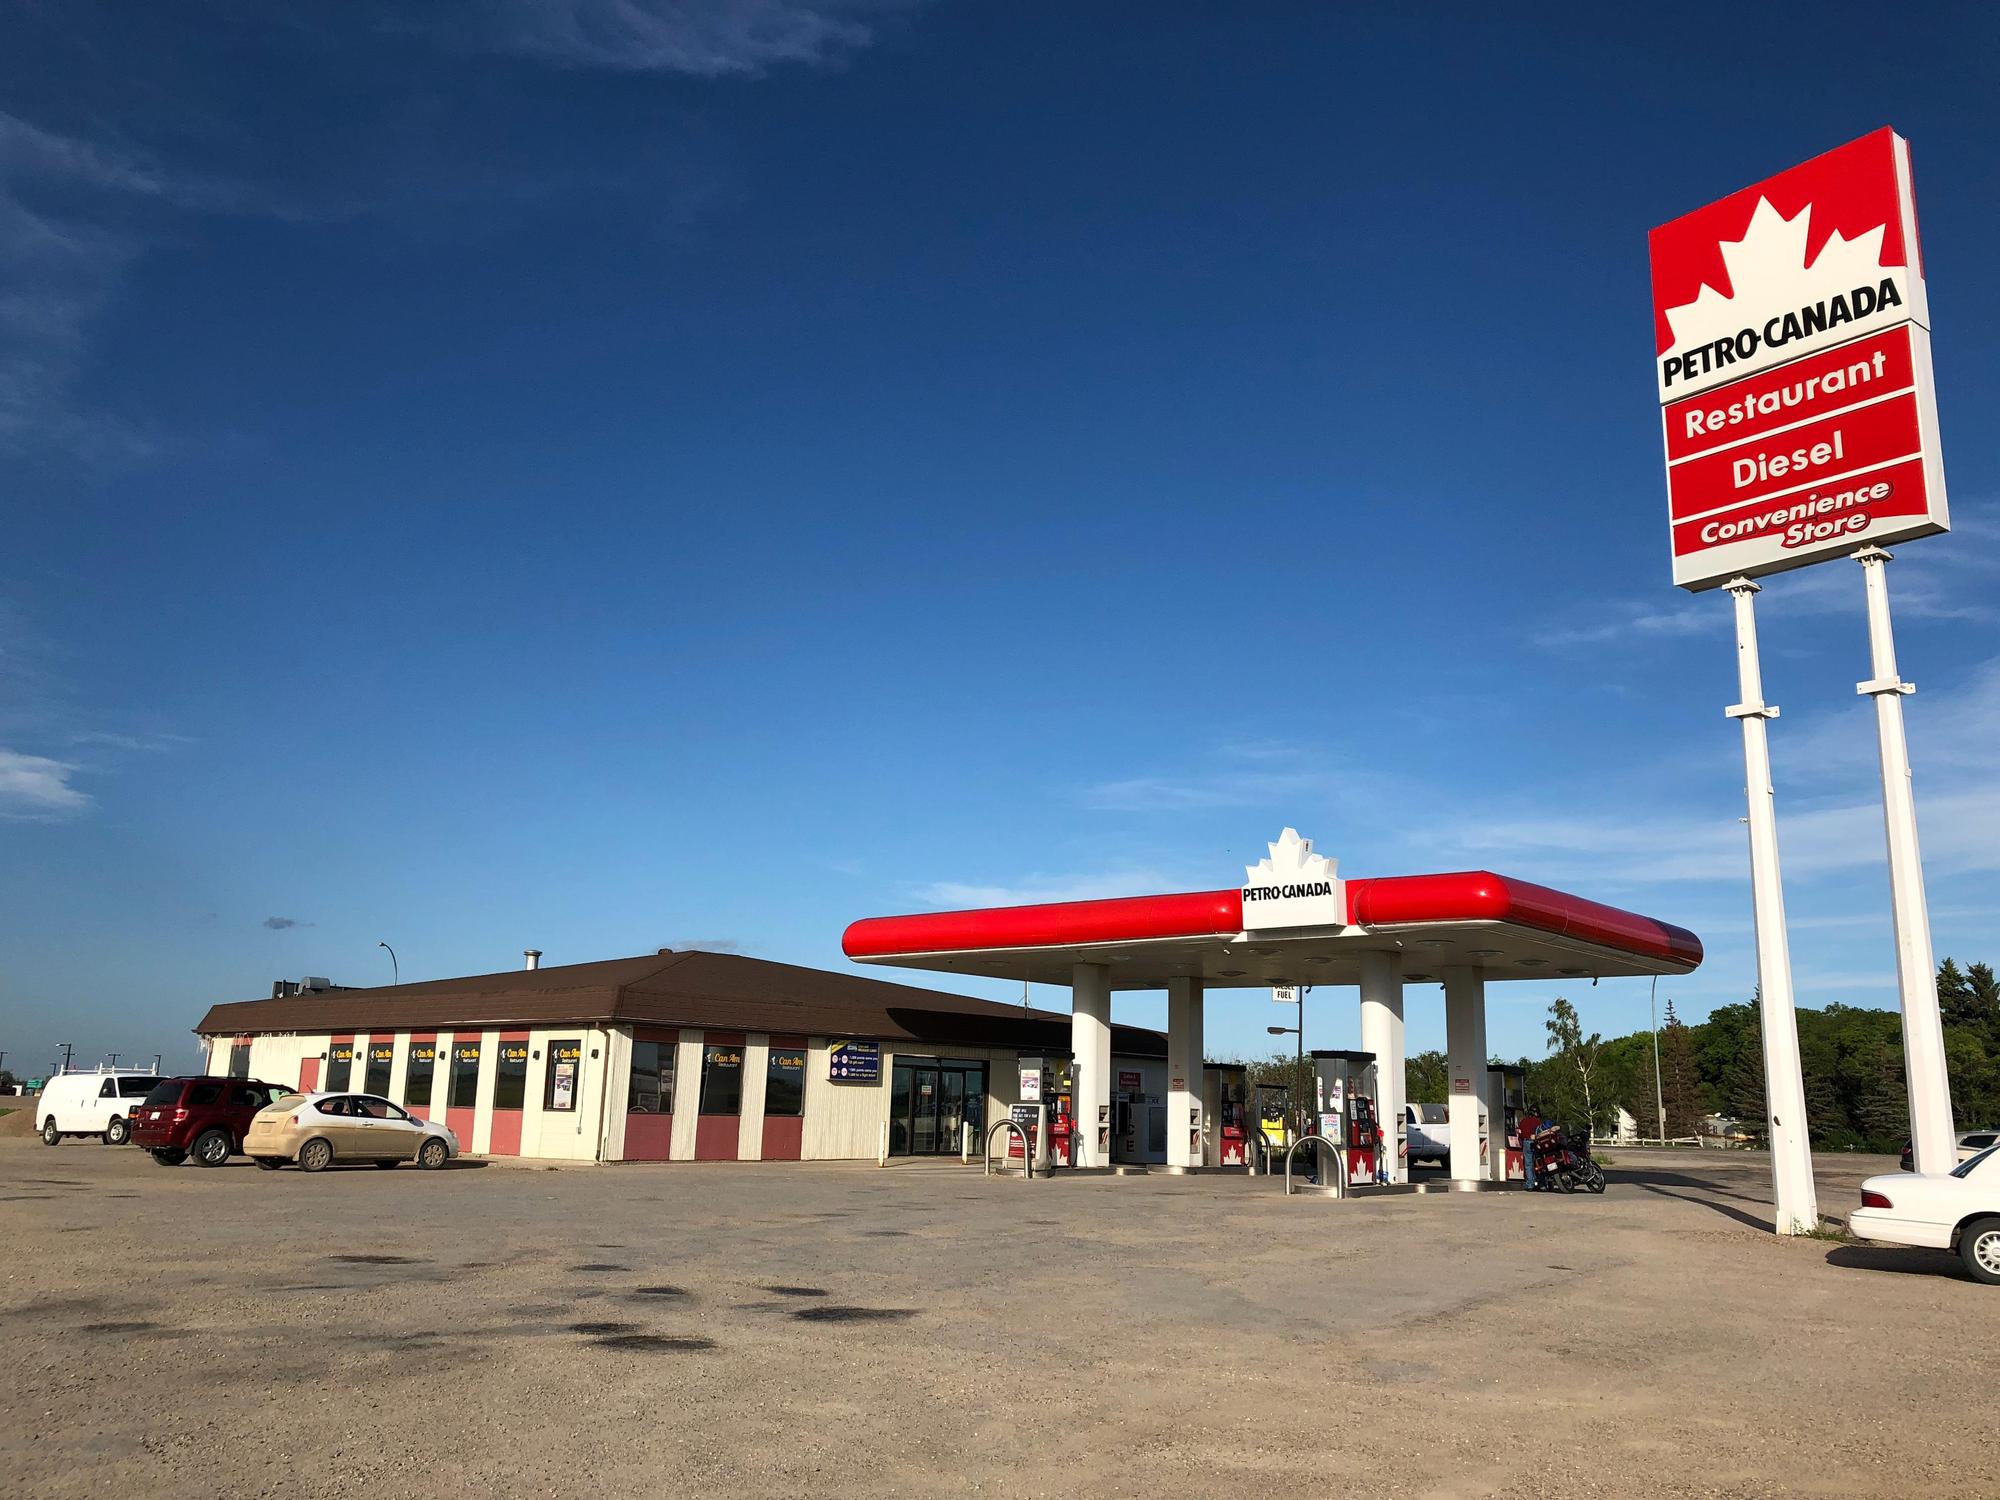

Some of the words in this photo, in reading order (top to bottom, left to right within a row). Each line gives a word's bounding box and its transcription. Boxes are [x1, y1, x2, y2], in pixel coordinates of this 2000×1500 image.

[1685, 350, 1887, 439] Restaurant
[1732, 430, 1844, 489] Diesel
[1700, 481, 1892, 545] Convenience
[1784, 512, 1870, 548] Store
[1277, 991, 1292, 999] FUEL
[714, 1053, 728, 1062] Can
[729, 1054, 740, 1063] Am
[778, 1056, 792, 1066] Can
[792, 1056, 803, 1066] Am
